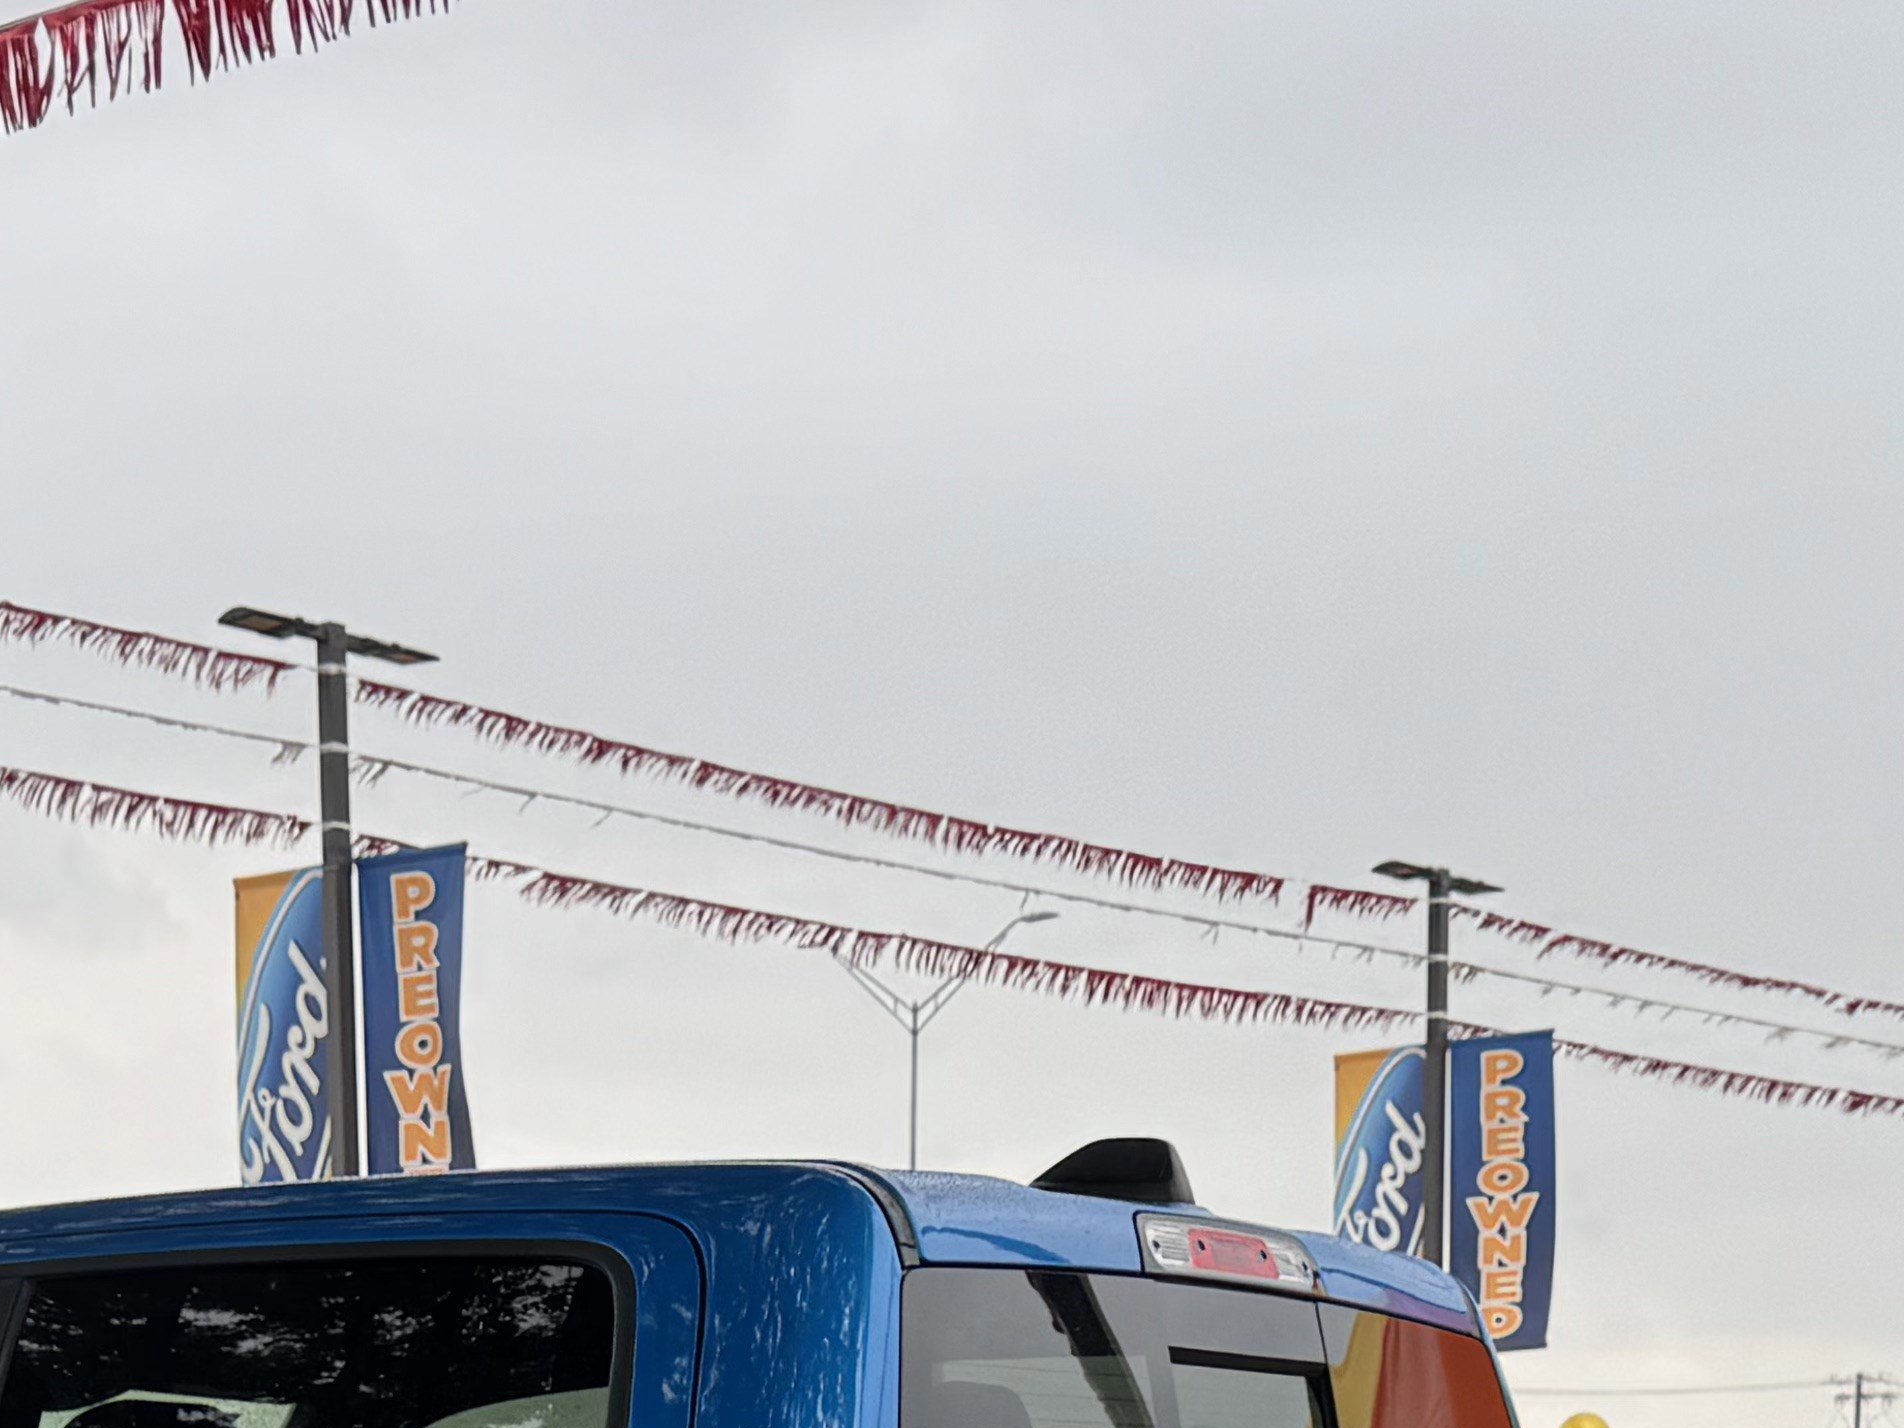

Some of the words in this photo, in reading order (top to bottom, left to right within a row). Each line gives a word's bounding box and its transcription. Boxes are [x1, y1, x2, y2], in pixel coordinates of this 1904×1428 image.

[240, 939, 329, 1184] Ford
[383, 871, 452, 1176] PREOWN
[1465, 1048, 1540, 1340] PREOWNED
